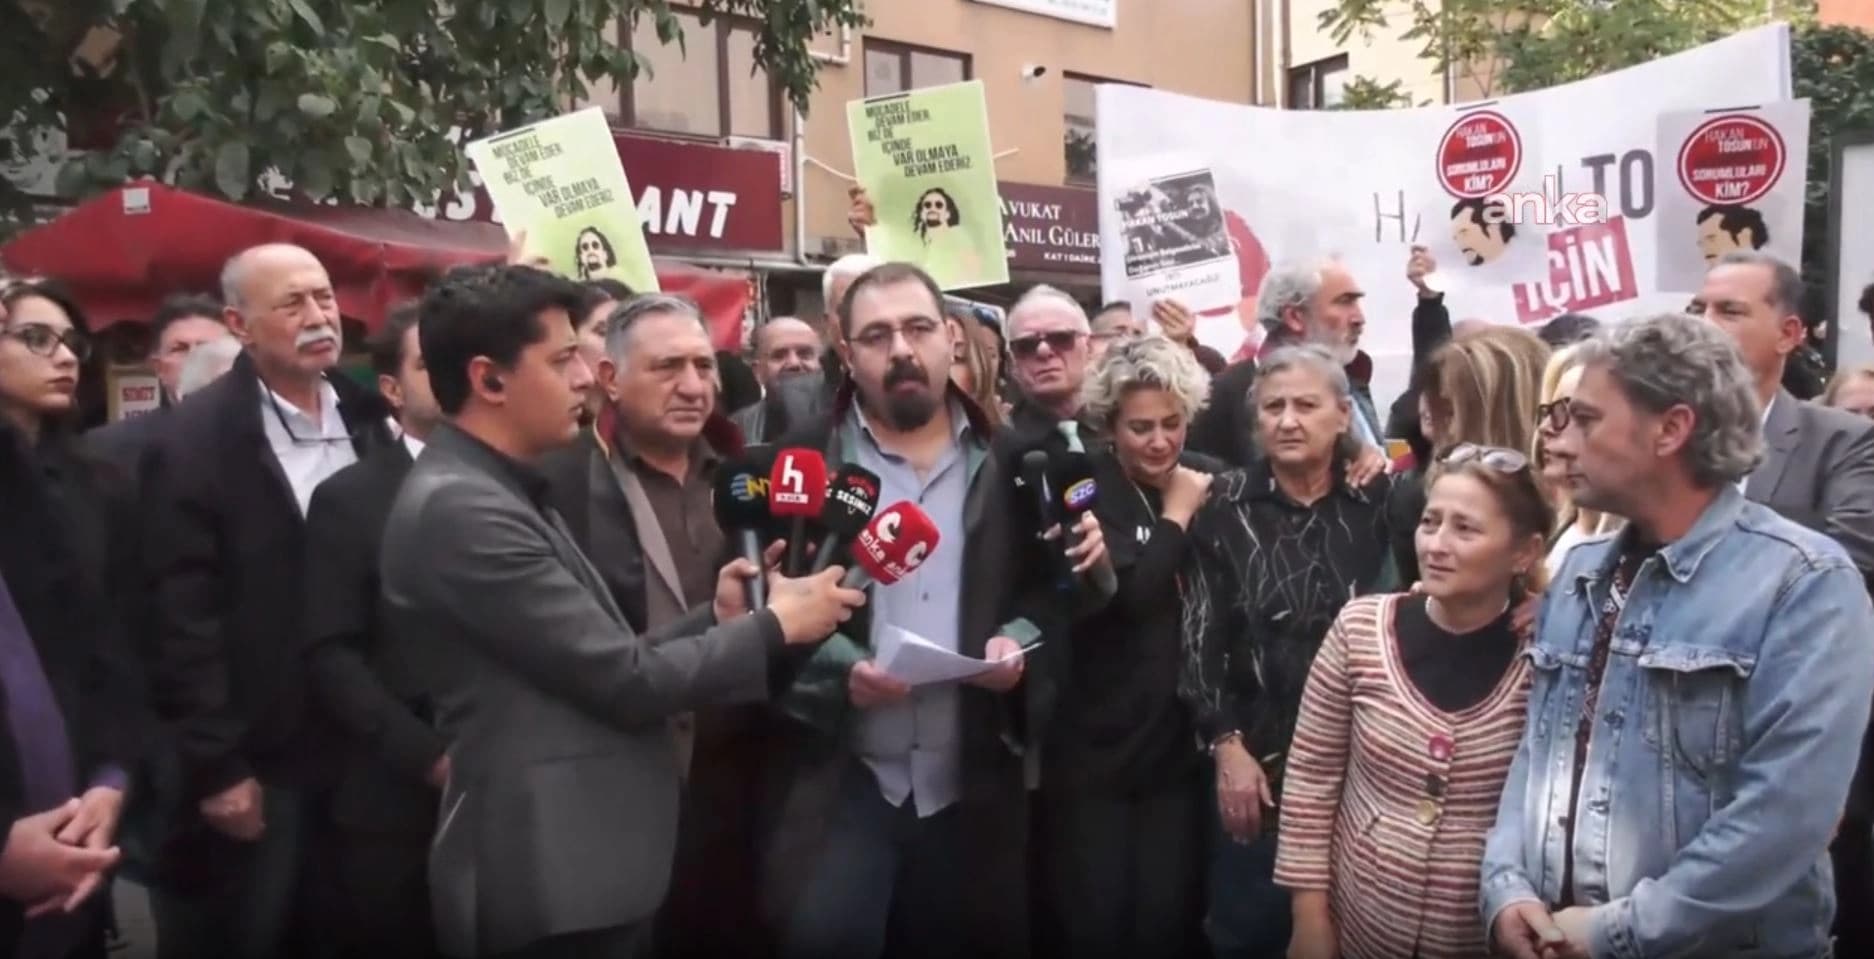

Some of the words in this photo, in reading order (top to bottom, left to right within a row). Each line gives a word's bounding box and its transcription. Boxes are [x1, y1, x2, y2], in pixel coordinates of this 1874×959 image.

[893, 150, 915, 166] VAR
[916, 143, 959, 163] OLMAYA
[904, 161, 937, 177] DEVAM
[1004, 223, 1046, 246] ANIL
[1044, 252, 1063, 261] KAT
[860, 529, 886, 561] anka
